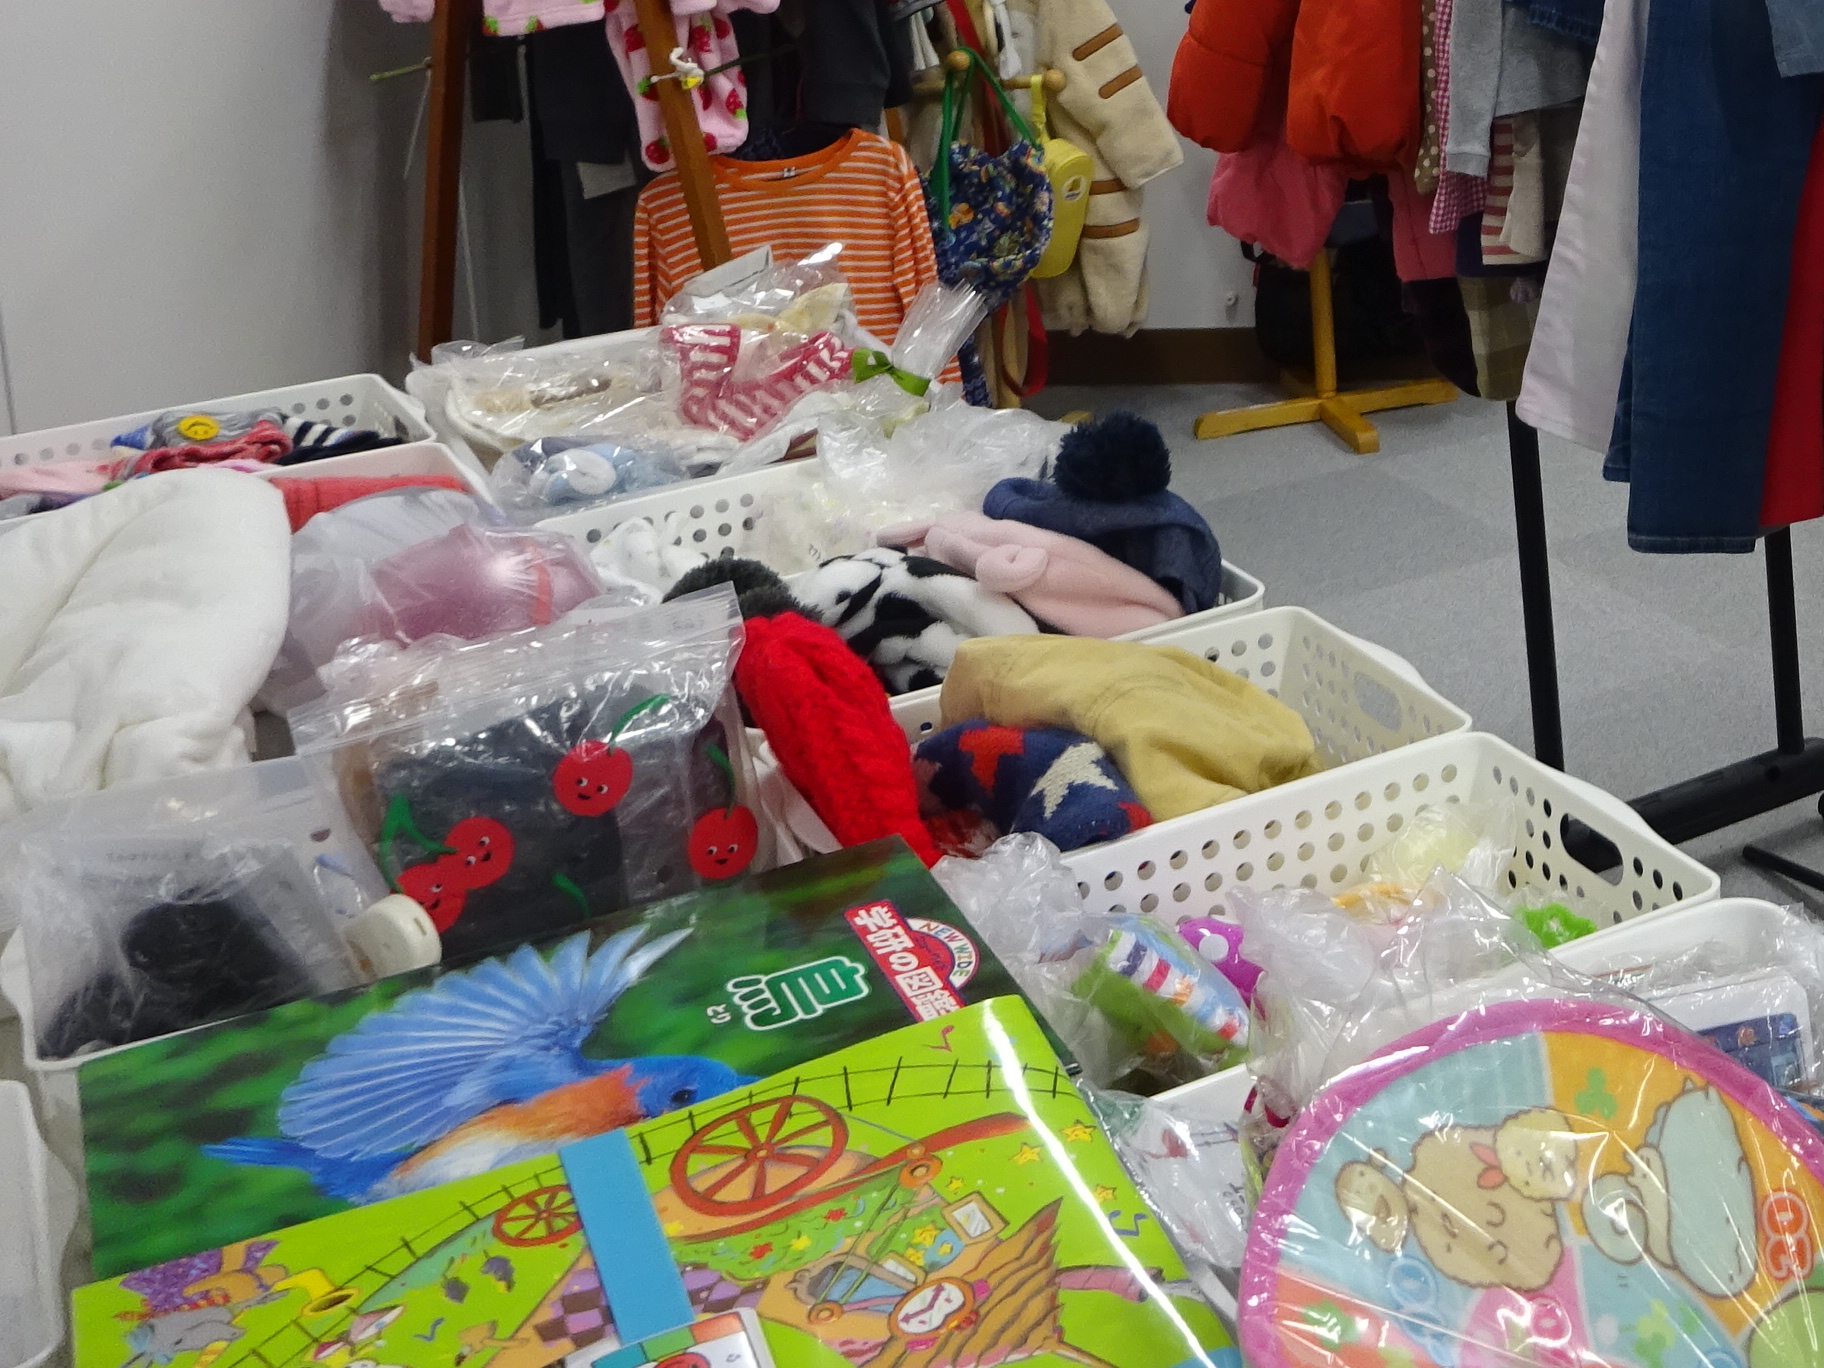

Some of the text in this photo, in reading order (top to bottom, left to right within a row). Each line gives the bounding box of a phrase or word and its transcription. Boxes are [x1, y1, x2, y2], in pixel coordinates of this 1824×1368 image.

[854, 904, 961, 1023] 学研の図鑑
[918, 922, 965, 943] NEW
[953, 943, 973, 978] WIDE
